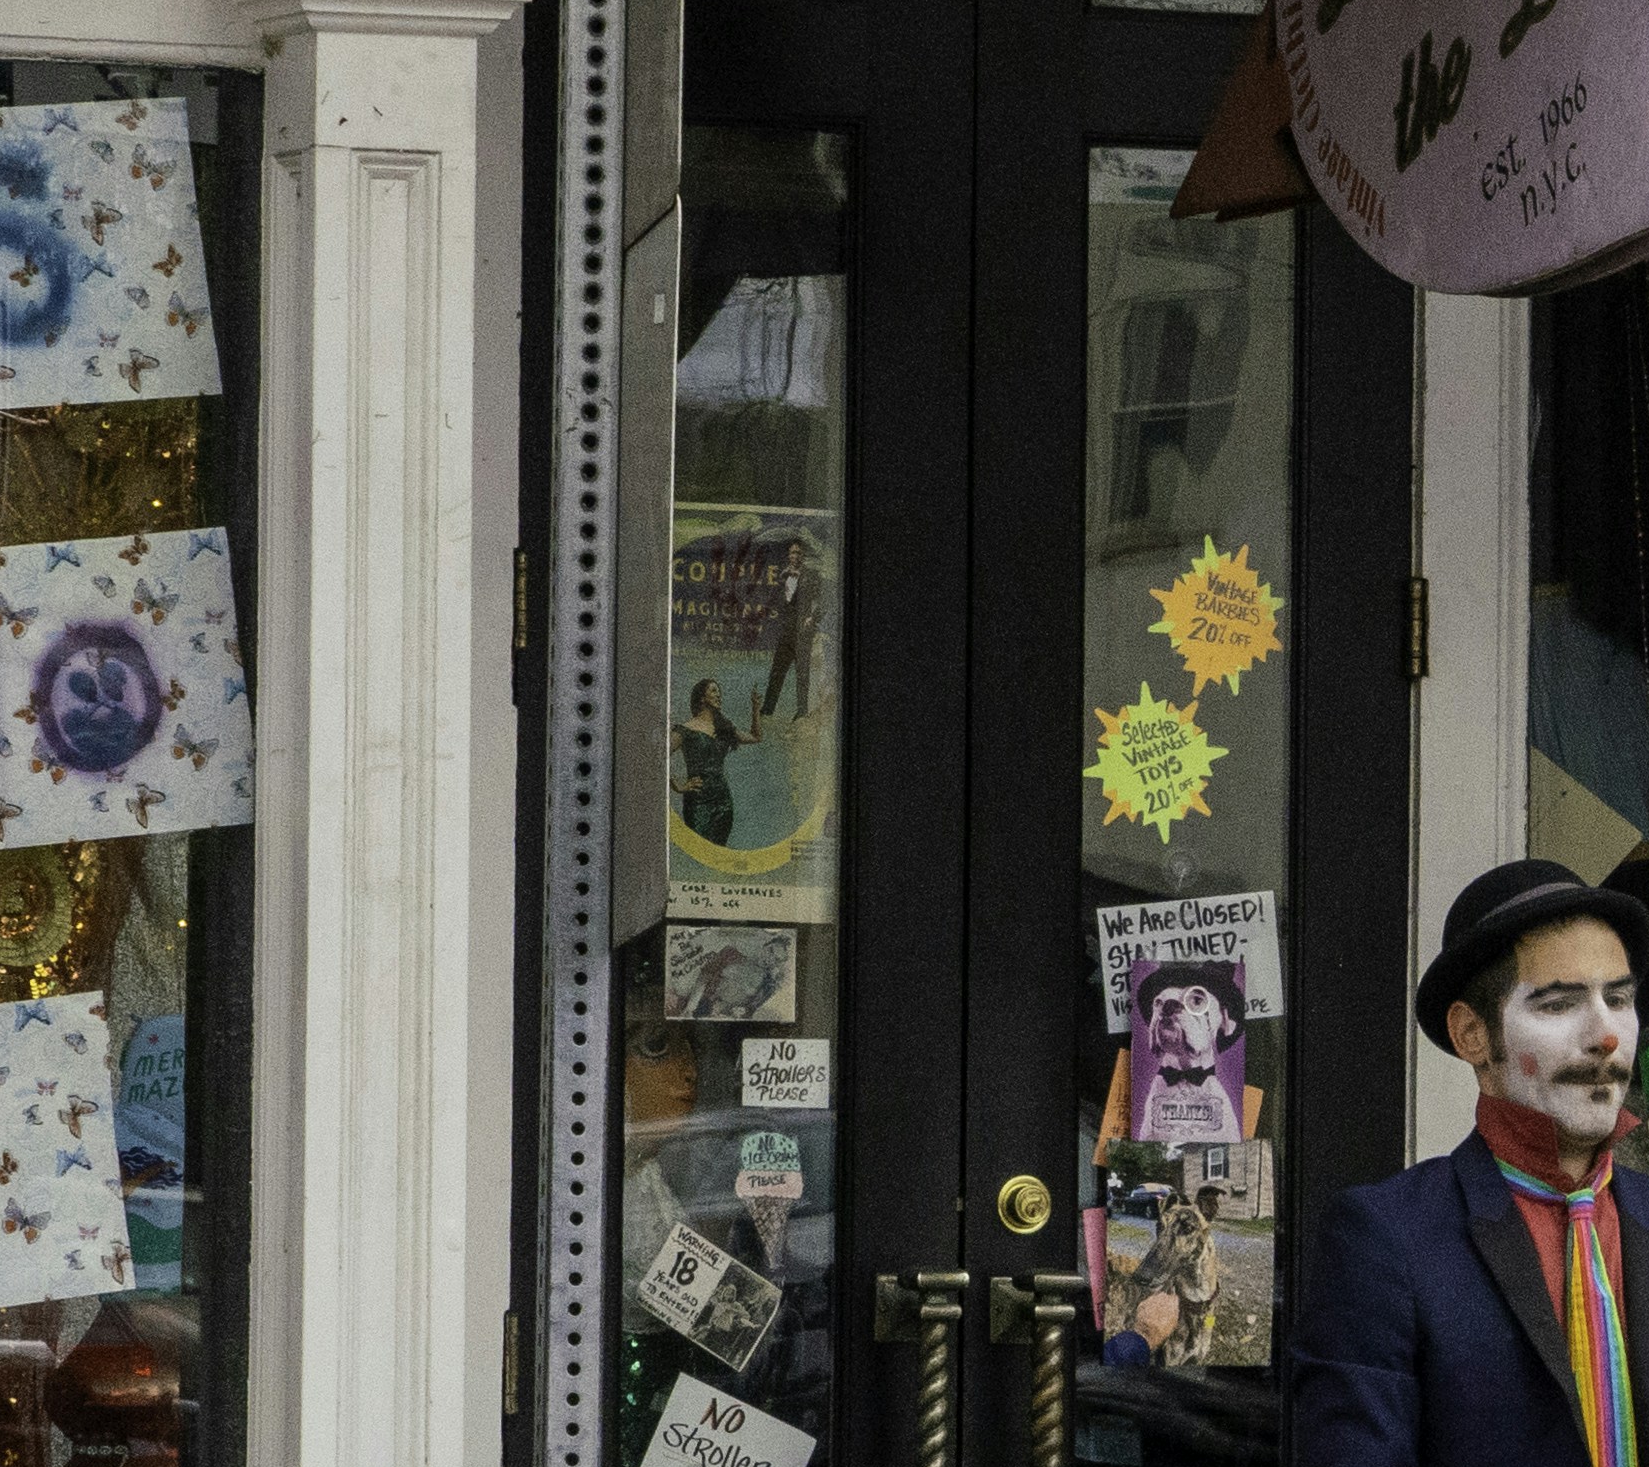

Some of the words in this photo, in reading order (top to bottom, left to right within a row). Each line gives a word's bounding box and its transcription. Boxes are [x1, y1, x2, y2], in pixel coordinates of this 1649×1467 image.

[1393, 31, 1472, 173] the
[1481, 139, 1528, 201] est.
[1537, 72, 1589, 147] 1966
[1518, 141, 1588, 227] n.y.c.
[1194, 591, 1261, 626] BARBIES
[1188, 616, 1227, 644] 20%
[1229, 631, 1252, 648] OFF
[1121, 734, 1192, 768] VINTAGE
[1132, 755, 1183, 785] TOYS
[1143, 780, 1180, 816] 20%
[768, 1041, 797, 1062] NO
[668, 1249, 699, 1286] 18
[699, 1396, 746, 1434] NO
